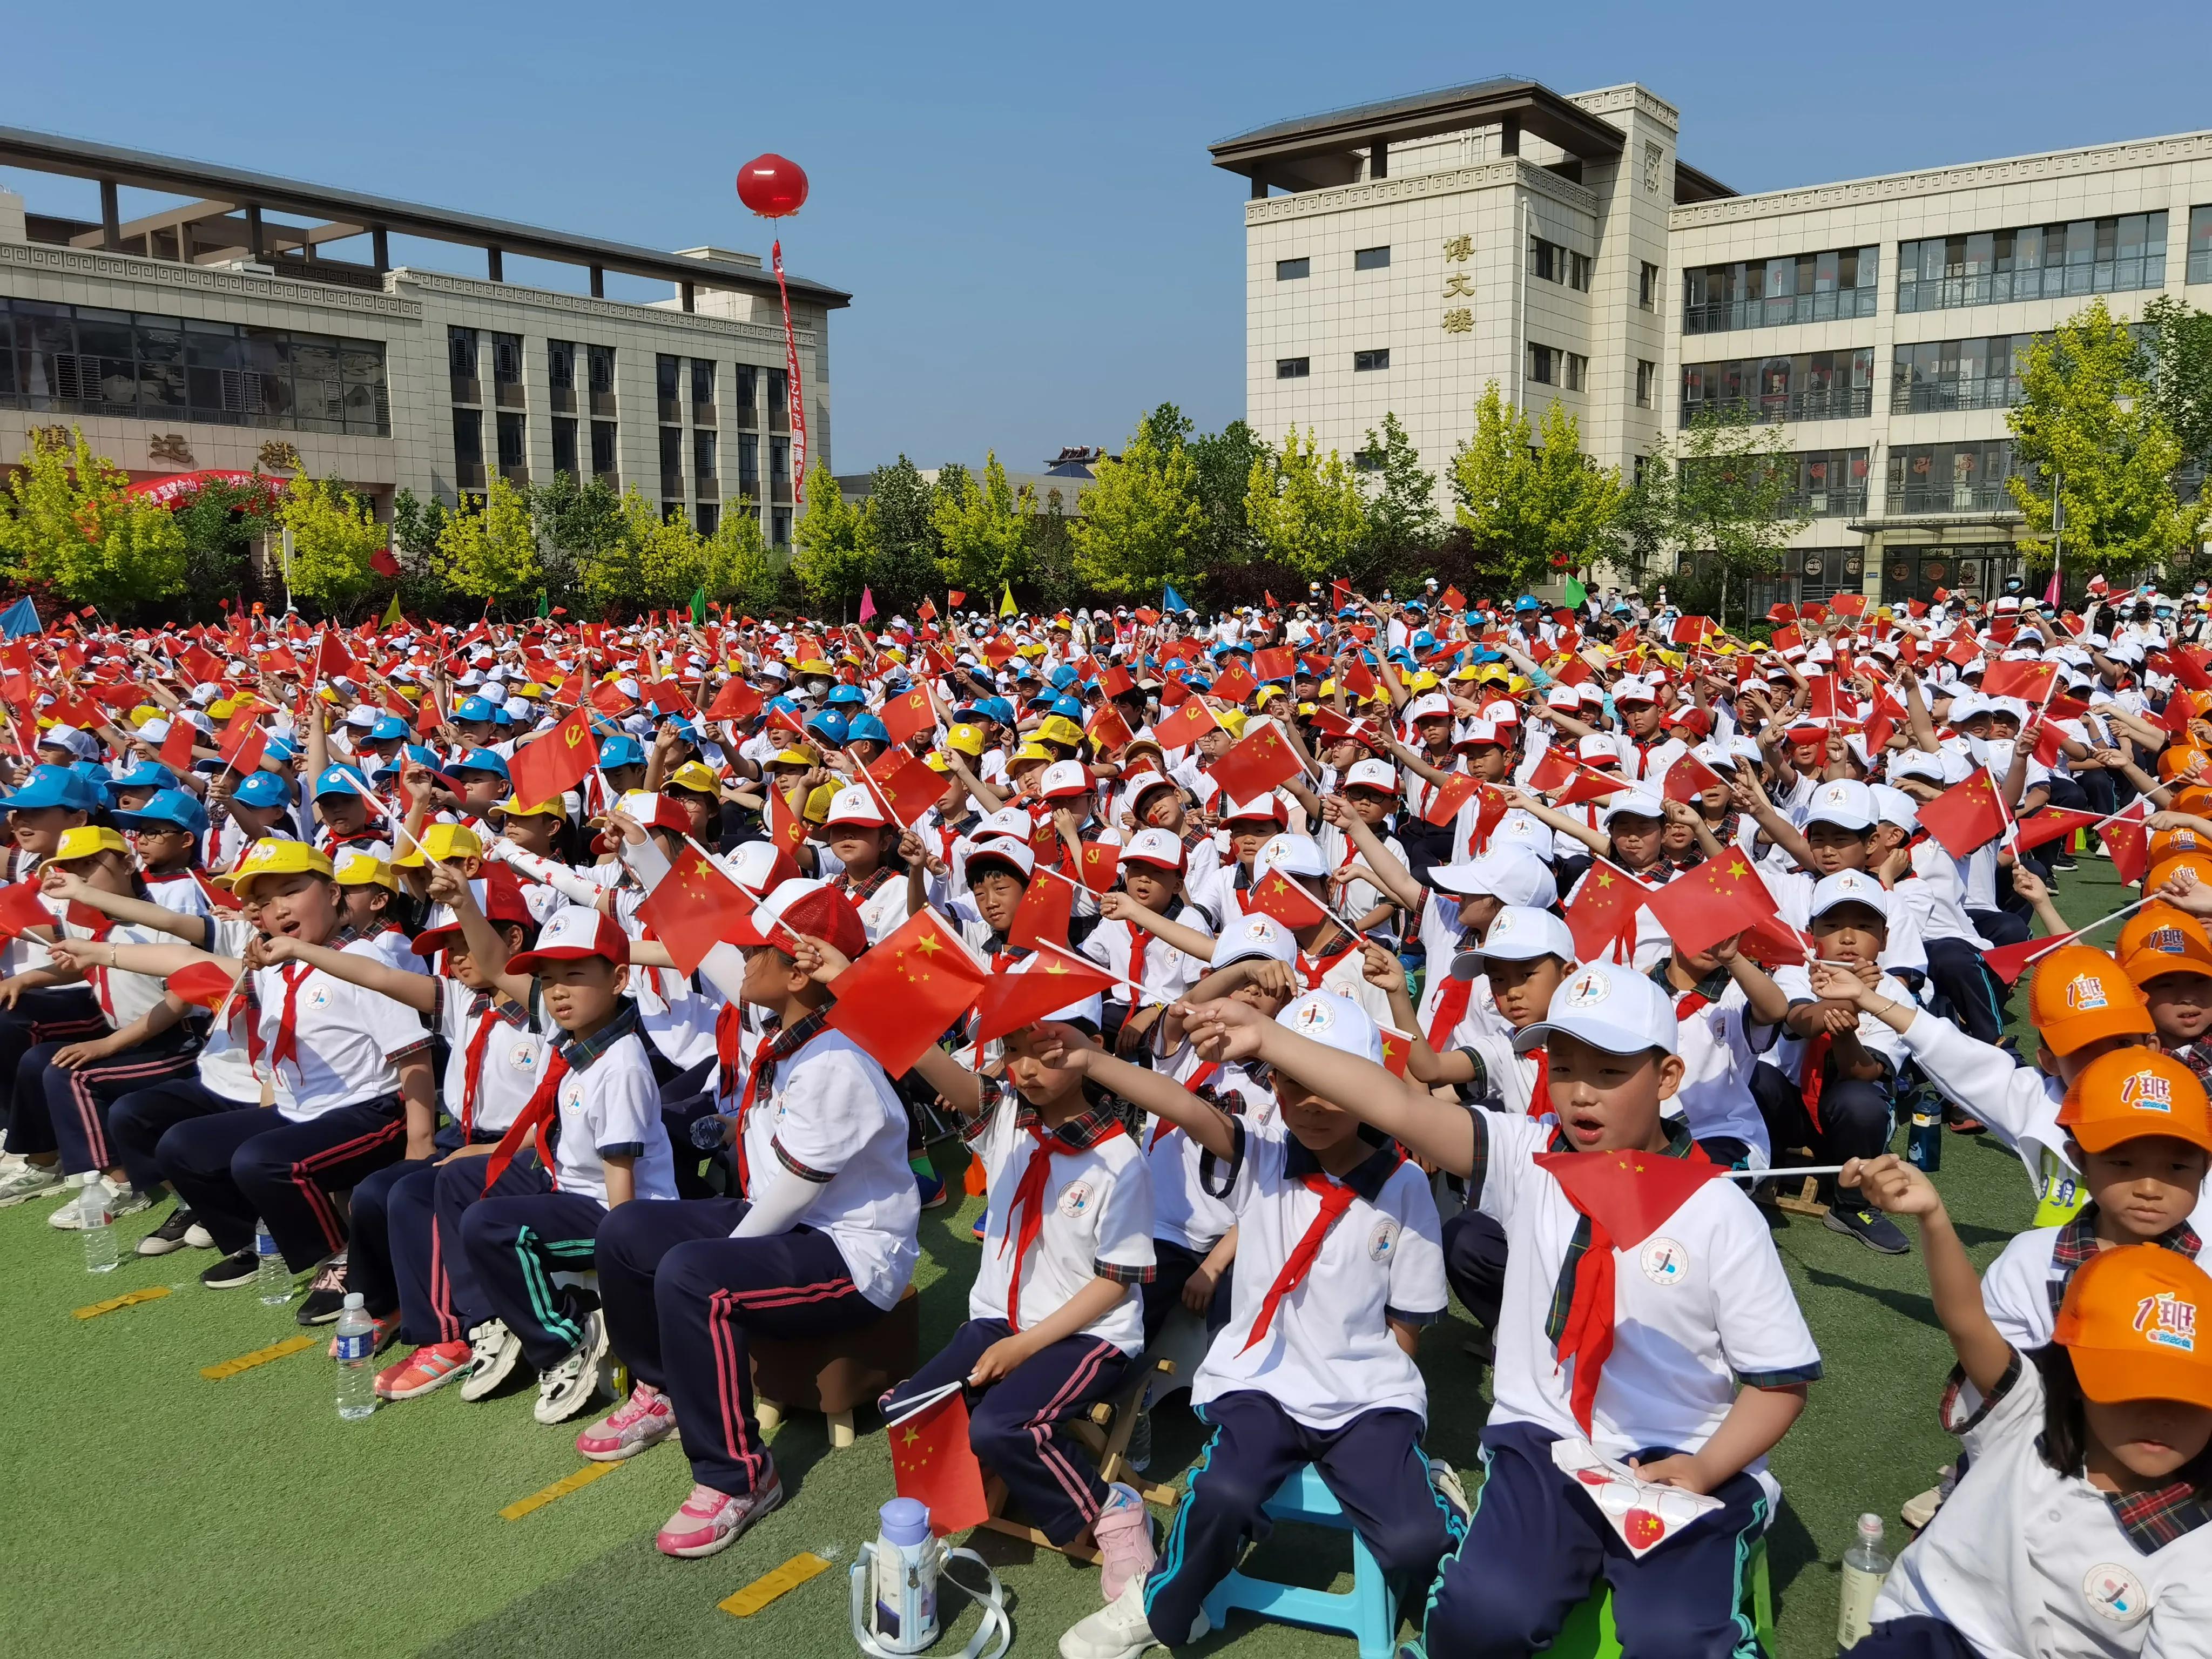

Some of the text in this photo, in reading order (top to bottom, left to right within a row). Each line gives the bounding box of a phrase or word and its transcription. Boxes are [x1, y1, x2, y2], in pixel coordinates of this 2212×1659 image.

[1442, 234, 1475, 333] 博文楼
[2150, 929, 2183, 949] 1班
[2067, 978, 2105, 1006] 1班
[2123, 1076, 2170, 1101] 1班
[2135, 1298, 2194, 1332] 1班
